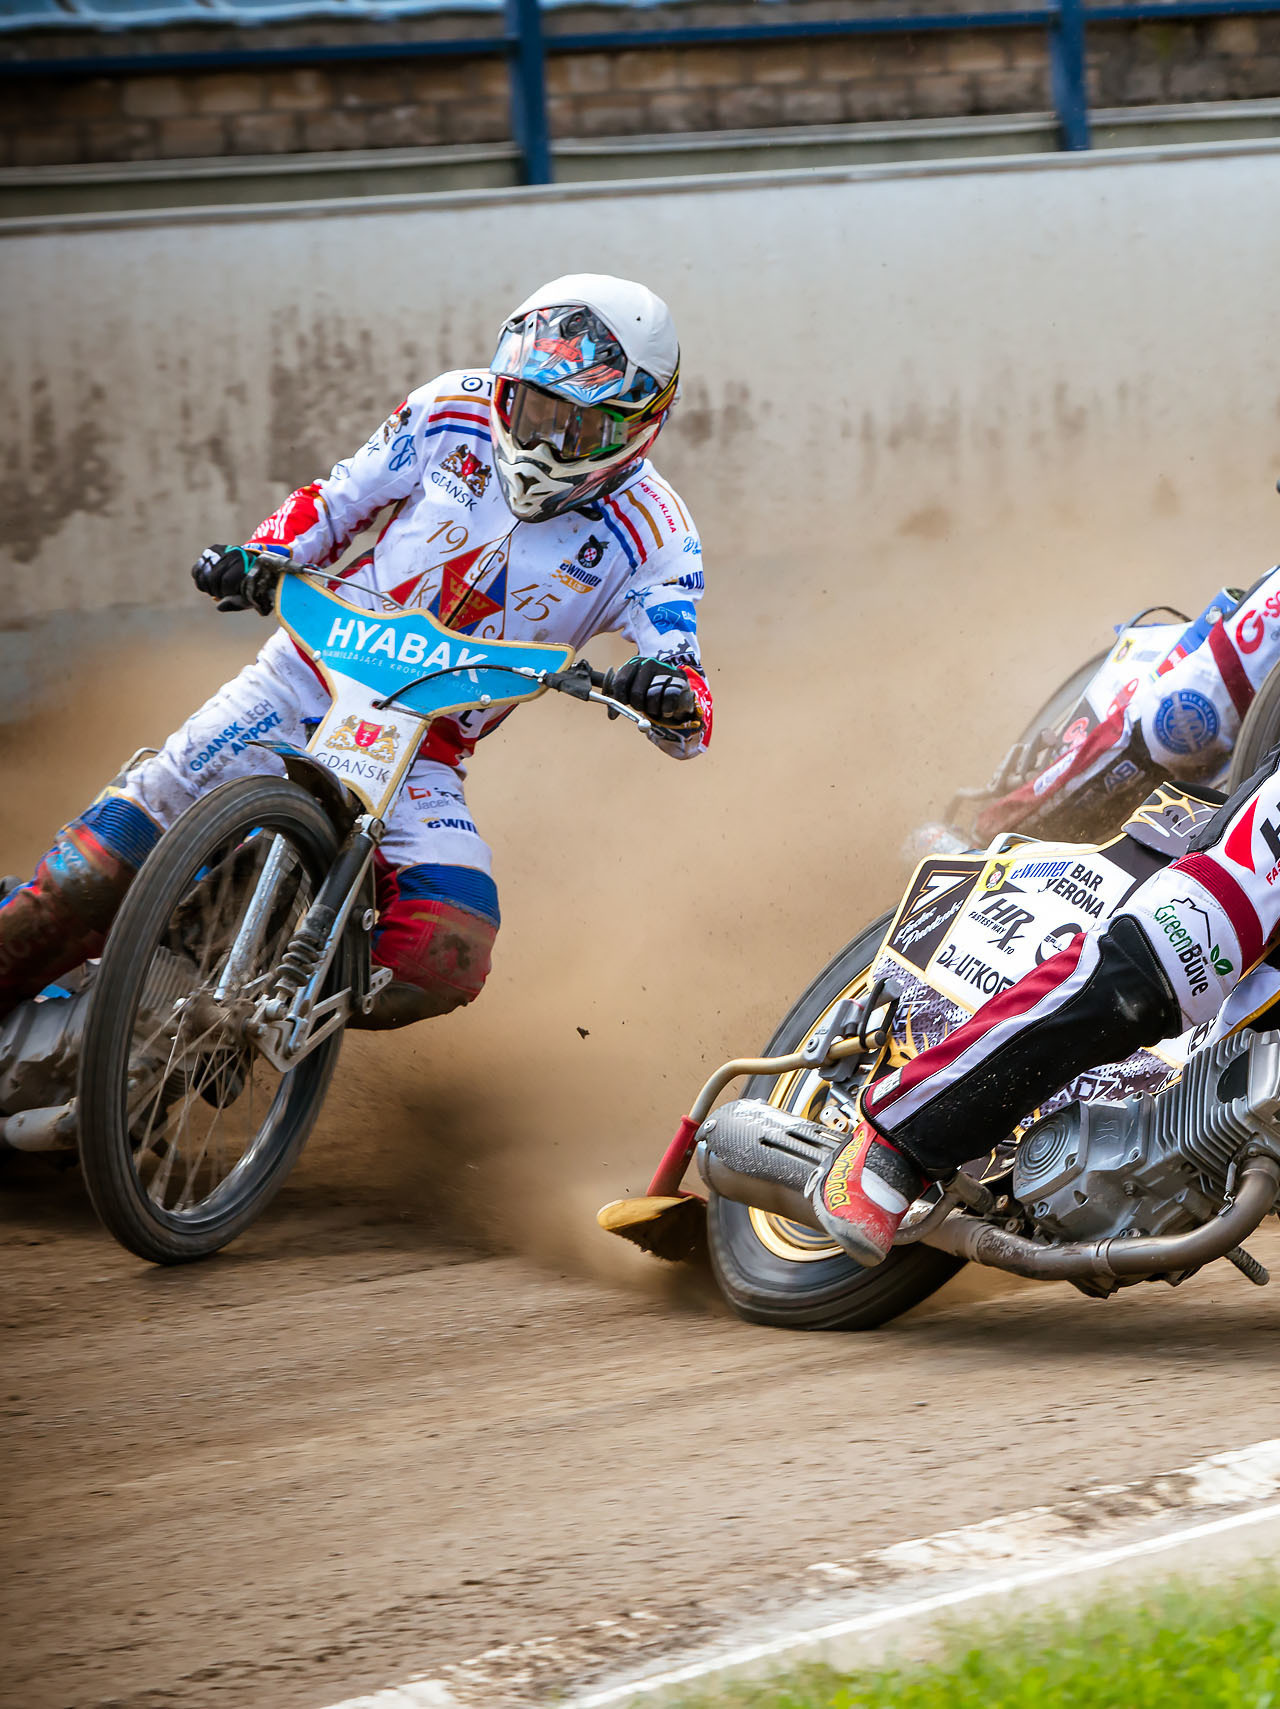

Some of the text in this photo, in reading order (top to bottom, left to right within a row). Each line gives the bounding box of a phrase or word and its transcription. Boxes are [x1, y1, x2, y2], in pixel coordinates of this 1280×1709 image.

[638, 479, 677, 534] NSTAL-KLIMA
[426, 519, 469, 554] 19
[559, 562, 602, 588] eWinner
[510, 583, 562, 622] 45
[326, 617, 489, 684] HYABAK
[189, 699, 275, 773] GDANSK LECH
[315, 752, 391, 784] GDAŃSK
[1069, 863, 1104, 893] BAR
[1041, 878, 1106, 919] VERONA
[968, 911, 1015, 955] FASTEST WAY TO
